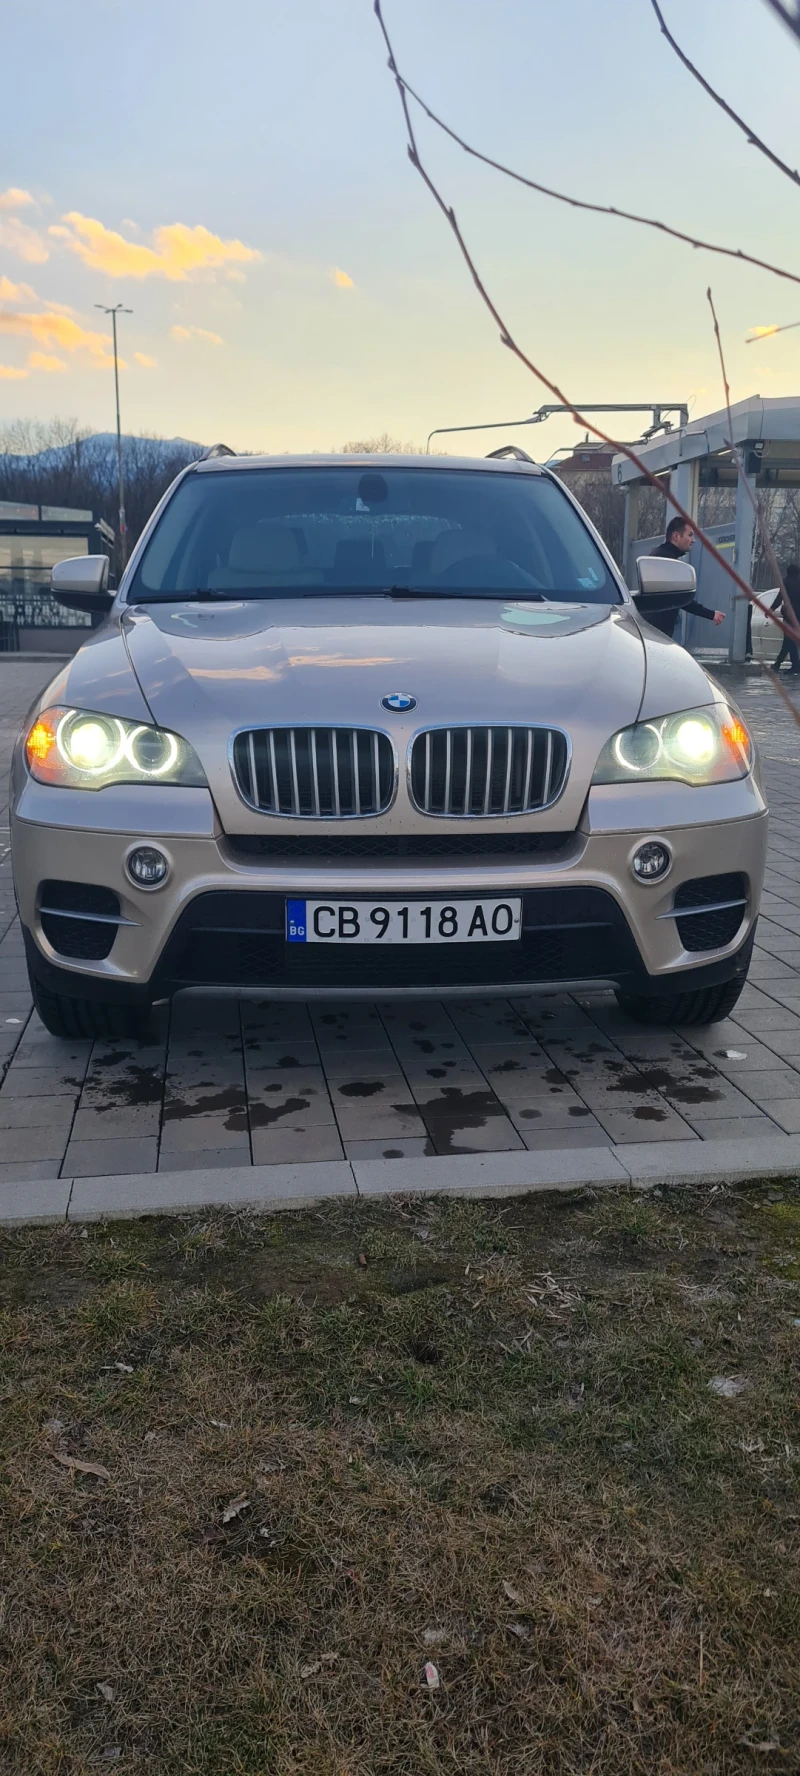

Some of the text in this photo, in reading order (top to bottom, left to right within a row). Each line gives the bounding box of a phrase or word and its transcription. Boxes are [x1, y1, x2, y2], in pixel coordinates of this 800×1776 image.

[617, 463, 623, 483] 6
[289, 926, 305, 936] BG
[313, 903, 513, 939] CB 9118 AO
